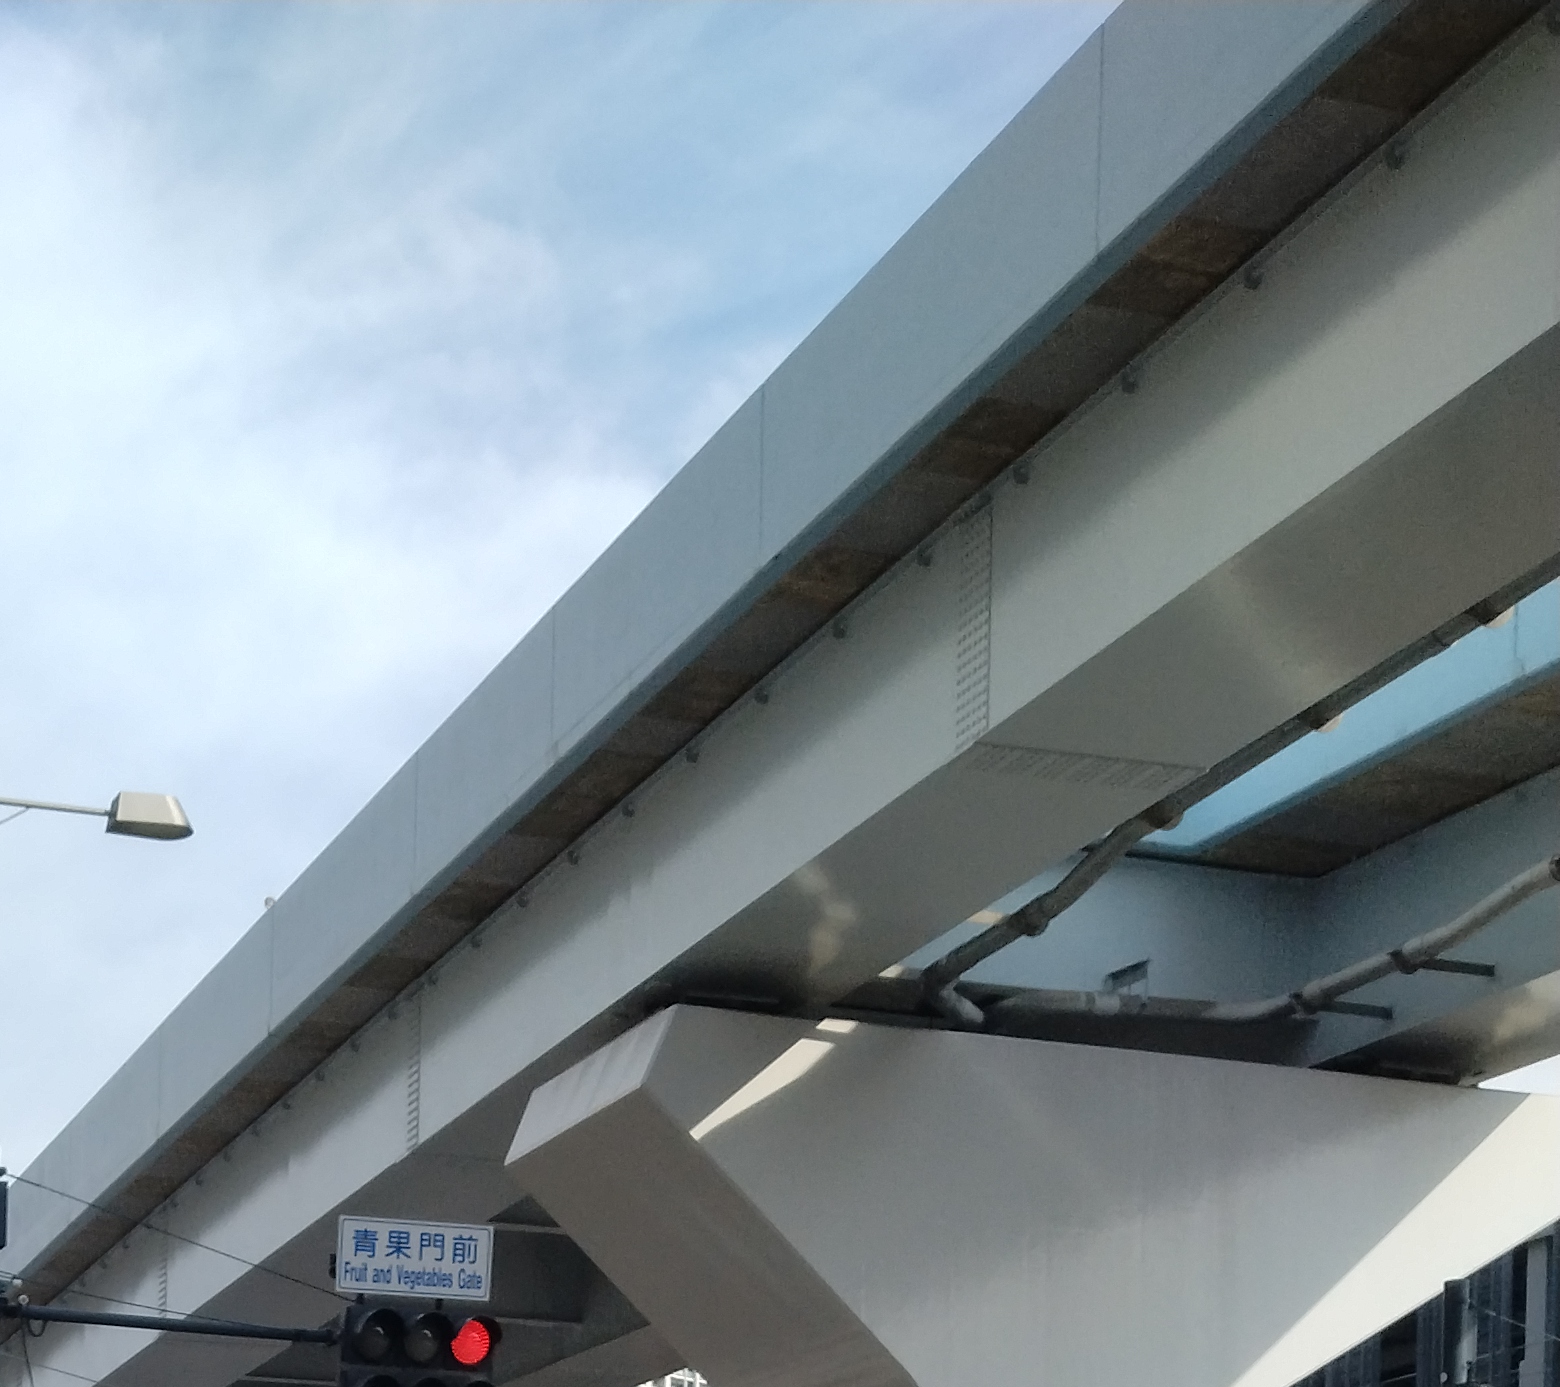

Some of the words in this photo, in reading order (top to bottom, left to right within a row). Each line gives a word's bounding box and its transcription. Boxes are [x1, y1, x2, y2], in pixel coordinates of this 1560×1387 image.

[352, 1227, 479, 1265] 青果門前
[344, 1261, 368, 1283] Fruit
[372, 1264, 391, 1284] and
[396, 1264, 454, 1290] Vegetables
[458, 1267, 483, 1290] Gate
